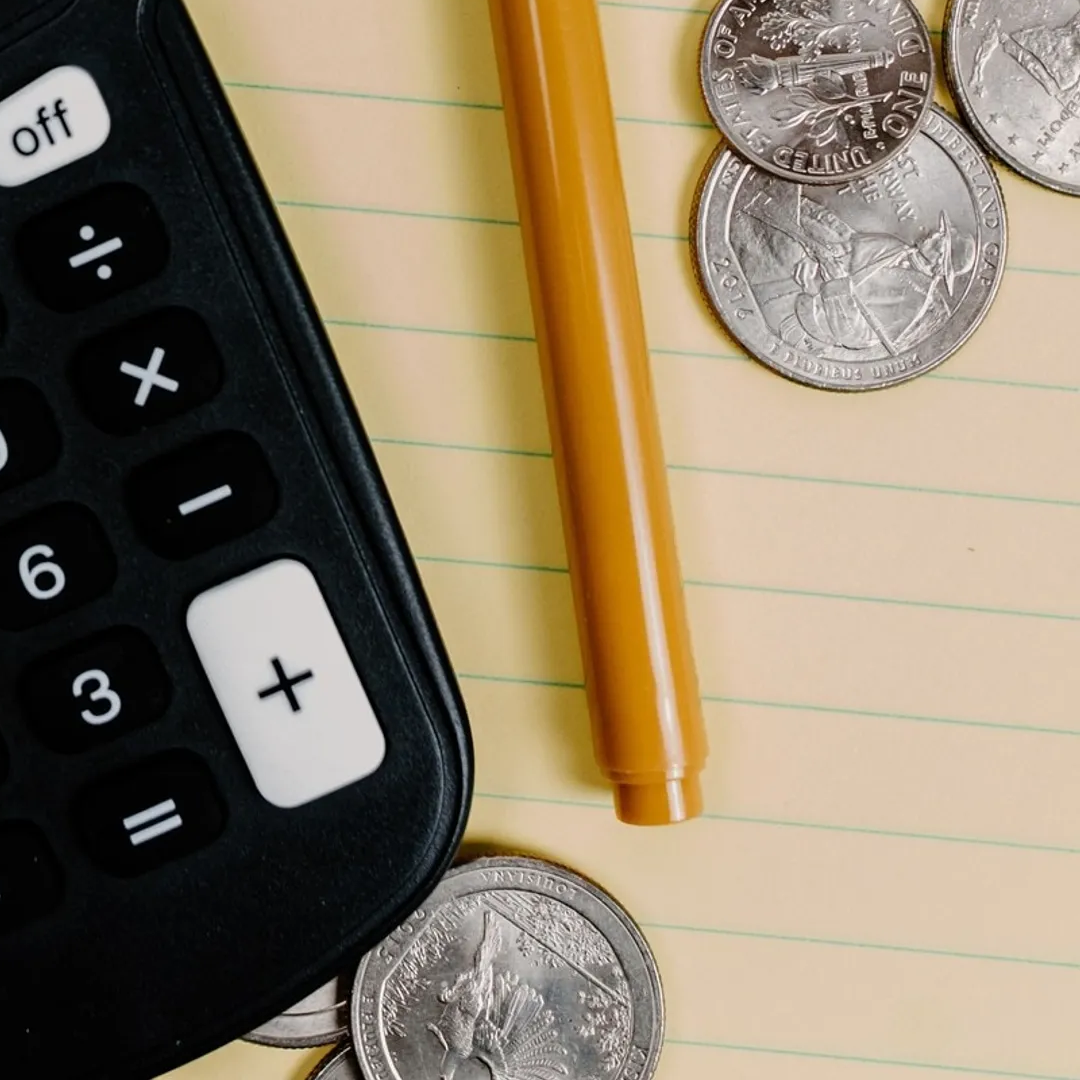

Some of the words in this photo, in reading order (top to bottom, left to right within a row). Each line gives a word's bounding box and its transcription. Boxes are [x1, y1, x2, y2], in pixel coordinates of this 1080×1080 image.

[713, 23, 737, 59] OF
[11, 98, 74, 157] off
[713, 67, 771, 153] STATES
[881, 70, 929, 139] ONE
[772, 146, 872, 175] UNITED
[711, 257, 755, 321] 2016
[978, 241, 1000, 287] GAP
[782, 351, 864, 381] PLURIBUS
[870, 353, 923, 381] UNUM
[20, 545, 65, 598] 6
[73, 670, 120, 724] 3
[479, 870, 576, 898] LOUISIANA
